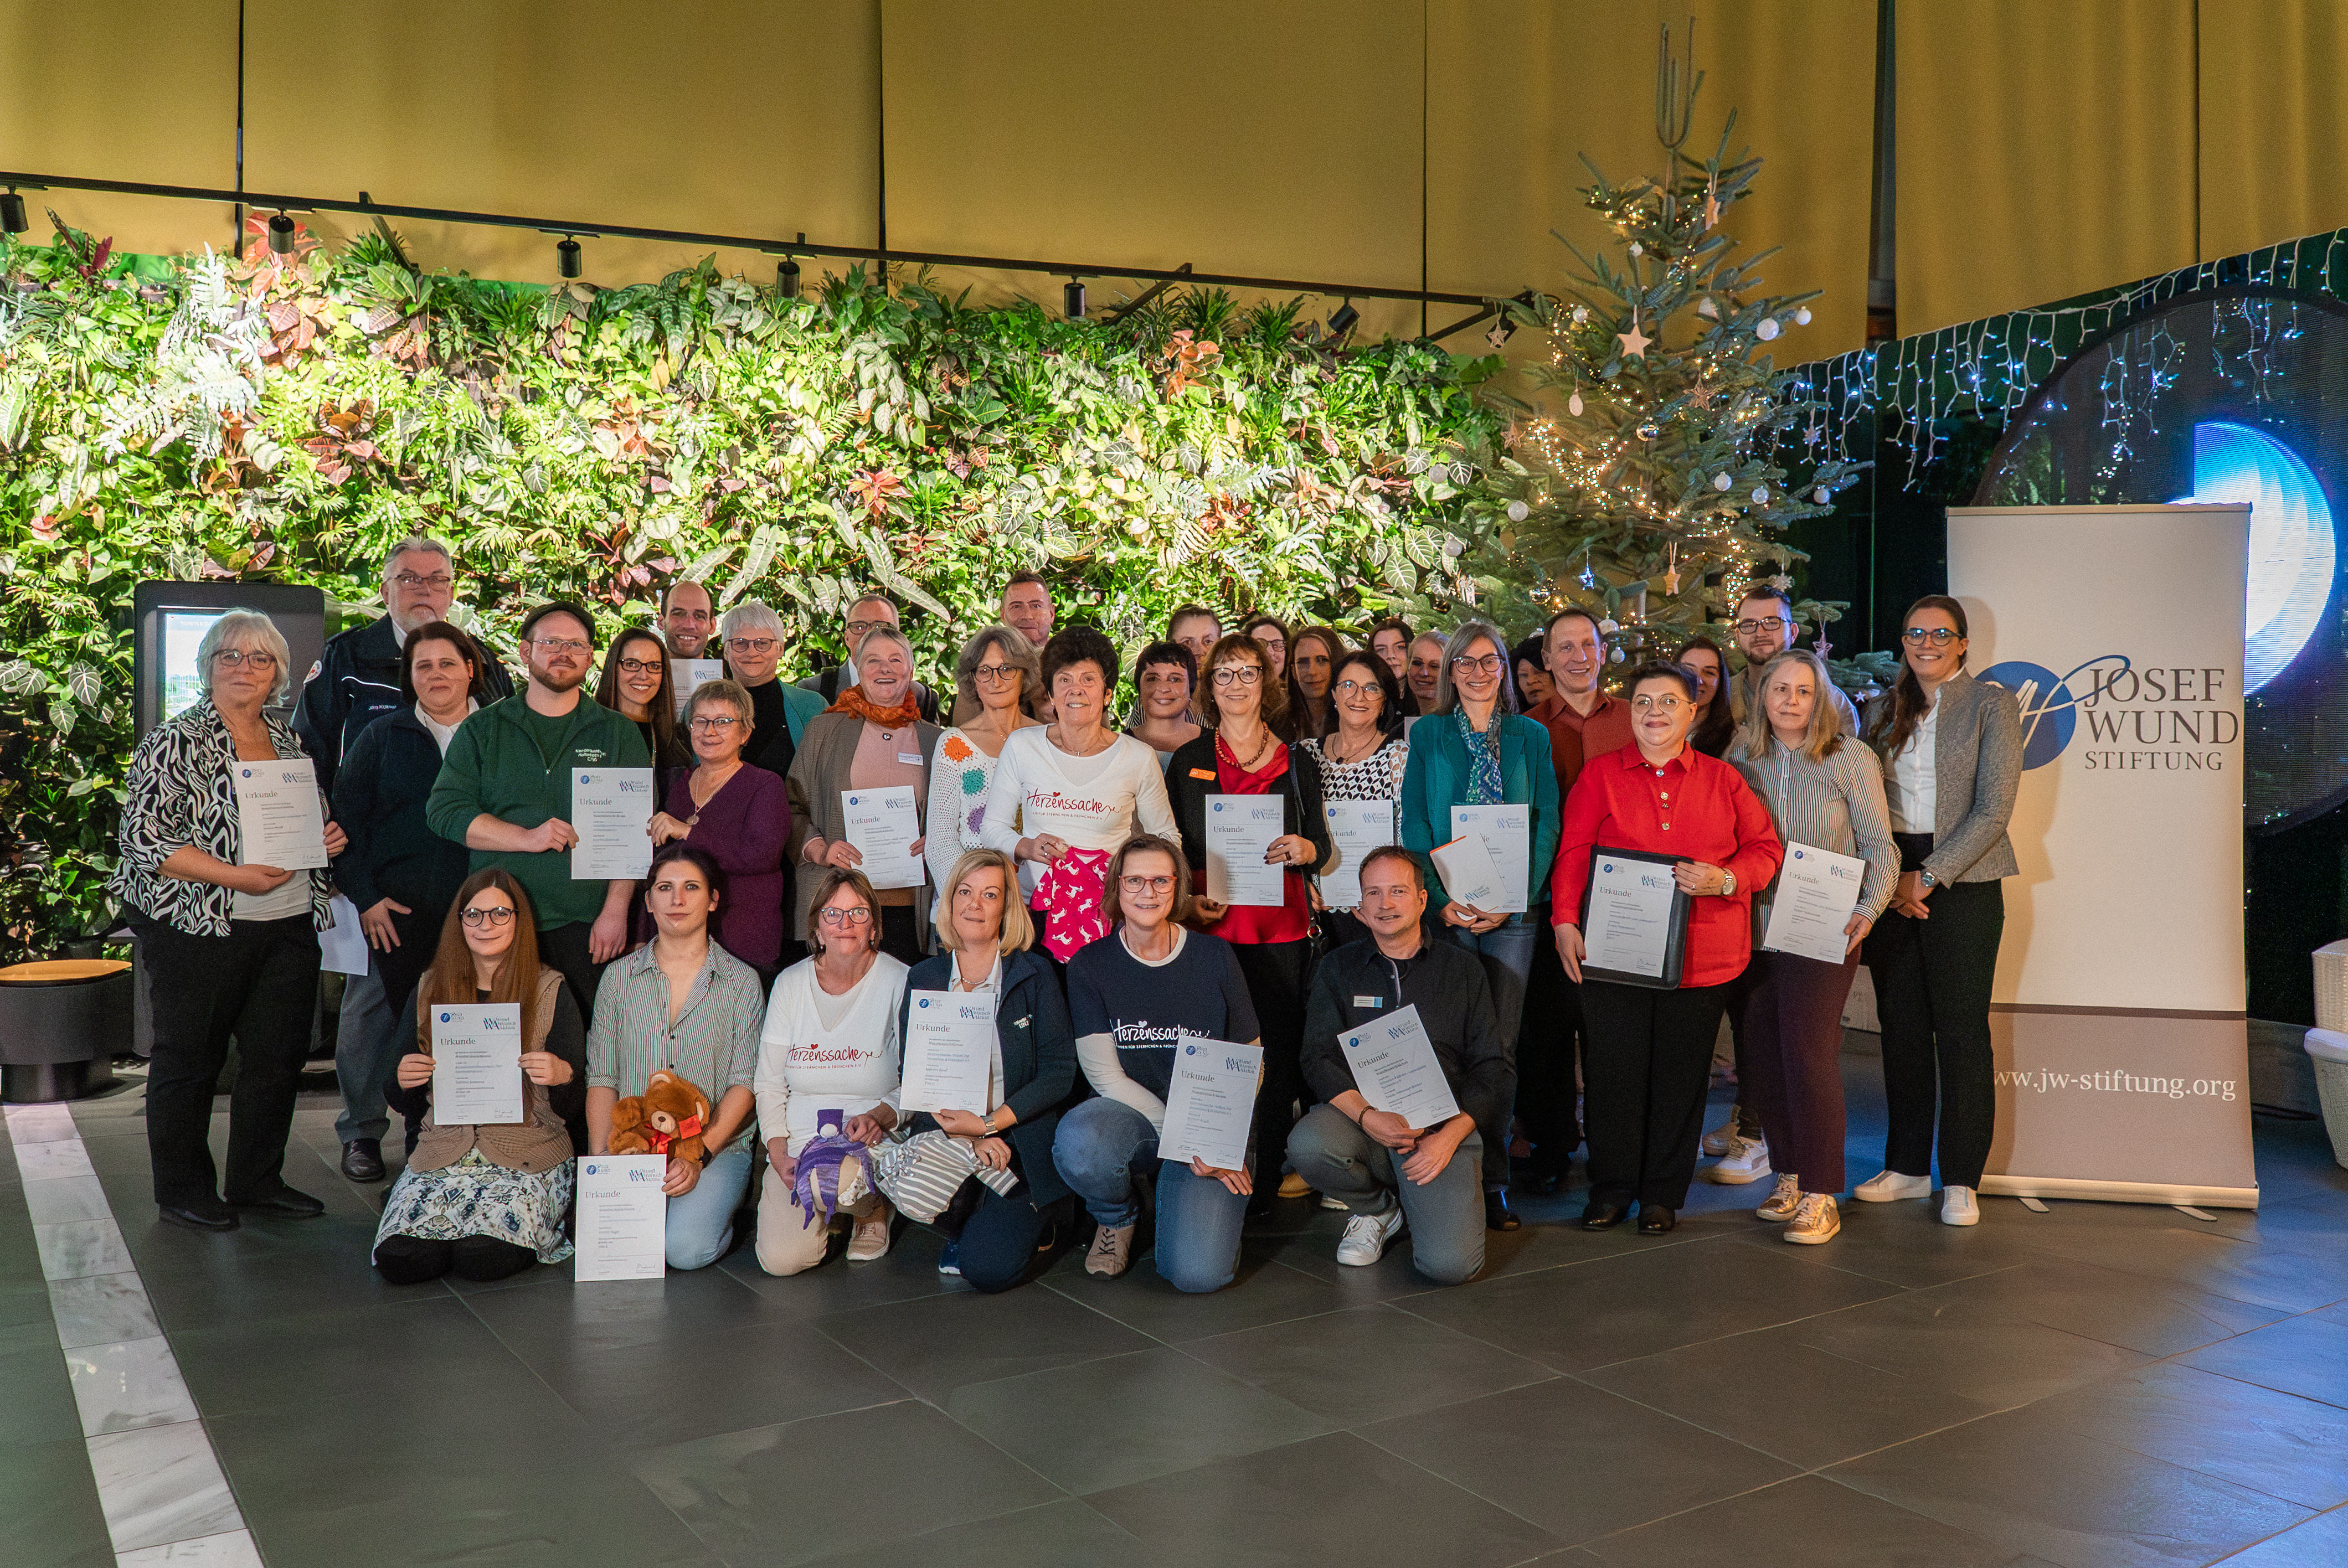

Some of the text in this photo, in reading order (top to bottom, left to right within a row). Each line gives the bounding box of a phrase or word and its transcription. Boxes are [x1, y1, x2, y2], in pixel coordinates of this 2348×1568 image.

[2084, 668, 2225, 708] JOSEF
[2084, 710, 2238, 744] WUND
[2085, 750, 2223, 771] STIFTUNG
[245, 791, 278, 799] Urkunde
[1027, 788, 1106, 814] Herzenssache
[1789, 871, 1820, 885] Urkunde
[1600, 886, 1631, 898] Urkunde
[916, 1024, 950, 1033] Urkunde
[1110, 1019, 1191, 1042] Herzenssache
[786, 1044, 862, 1064] Herzenssache
[1357, 1051, 1390, 1069] Urkunde
[1181, 1070, 1215, 1082] Urkunde
[1994, 1068, 2236, 1101] ww.jw-stiftung.org
